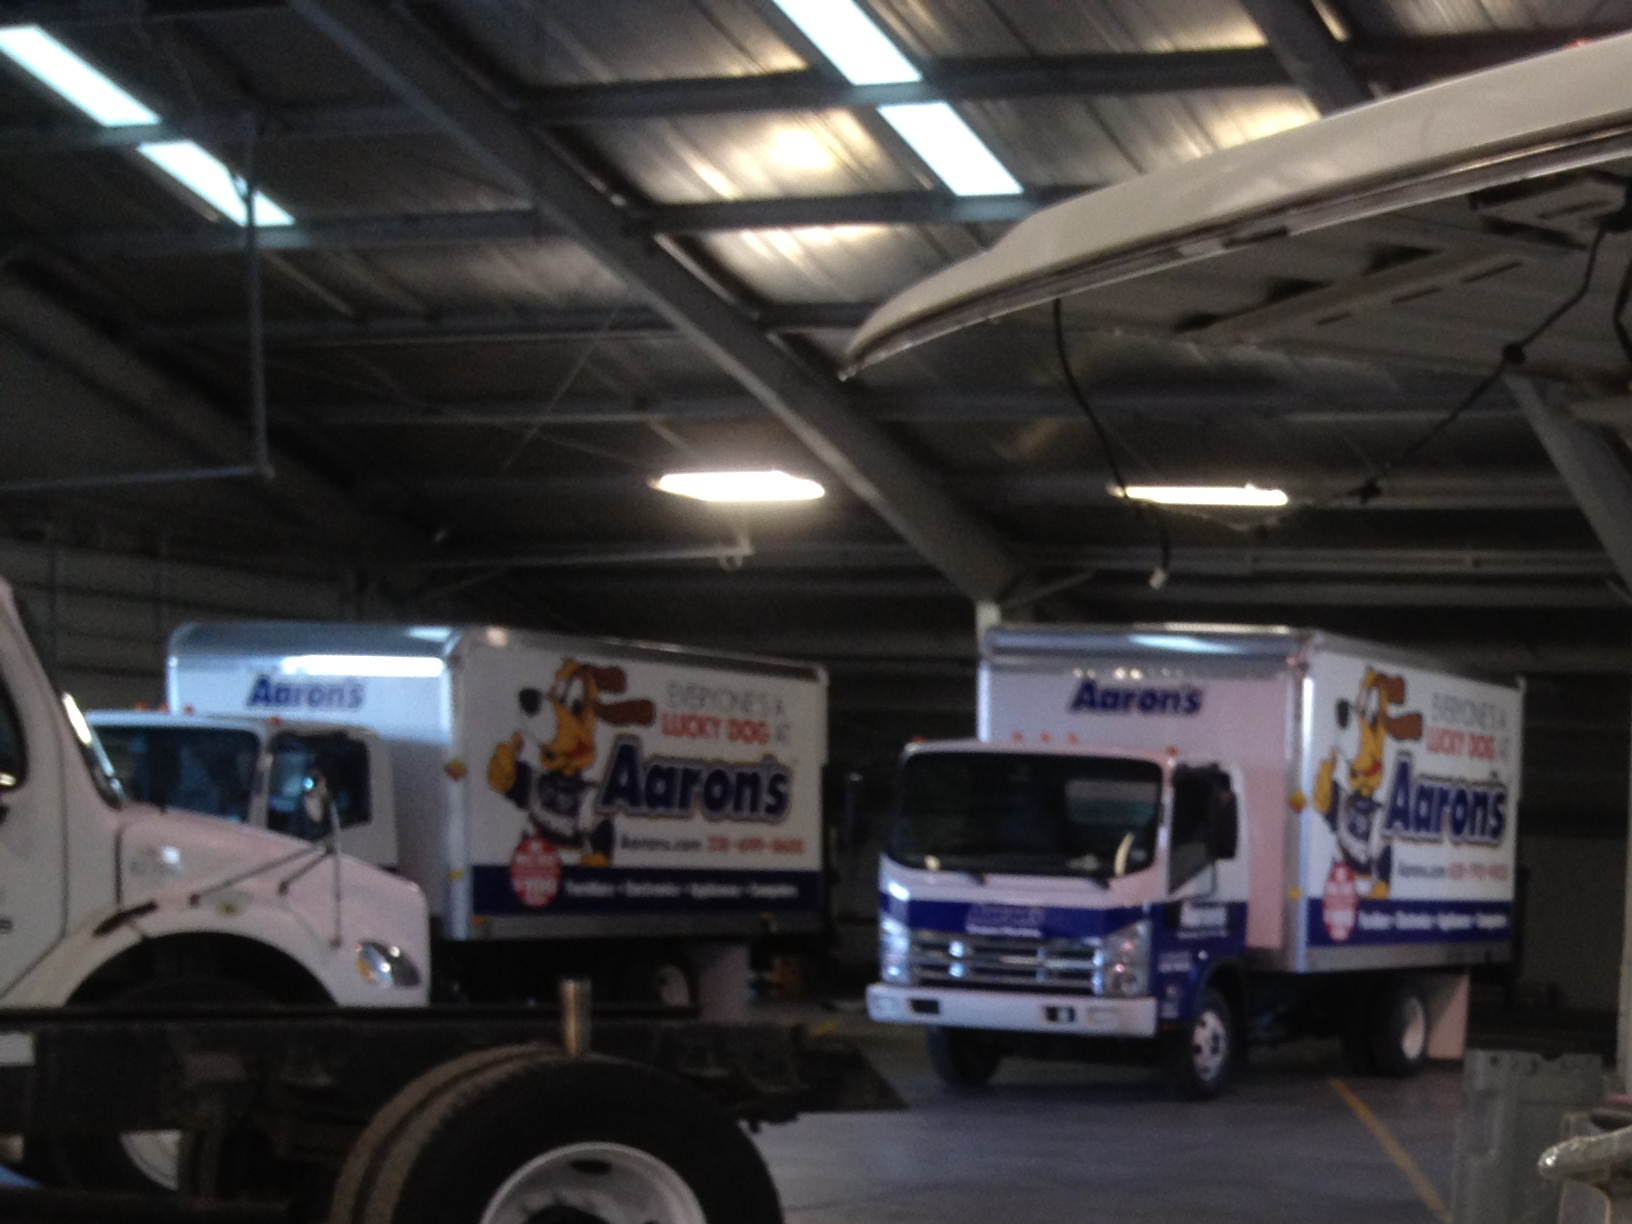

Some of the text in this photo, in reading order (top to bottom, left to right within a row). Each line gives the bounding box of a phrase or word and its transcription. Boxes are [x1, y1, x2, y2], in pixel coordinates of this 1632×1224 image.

[1069, 677, 1203, 715] Aaron's
[727, 718, 770, 746] DOG
[600, 738, 792, 821] Aaron's
[1385, 757, 1507, 843] Aaron's
